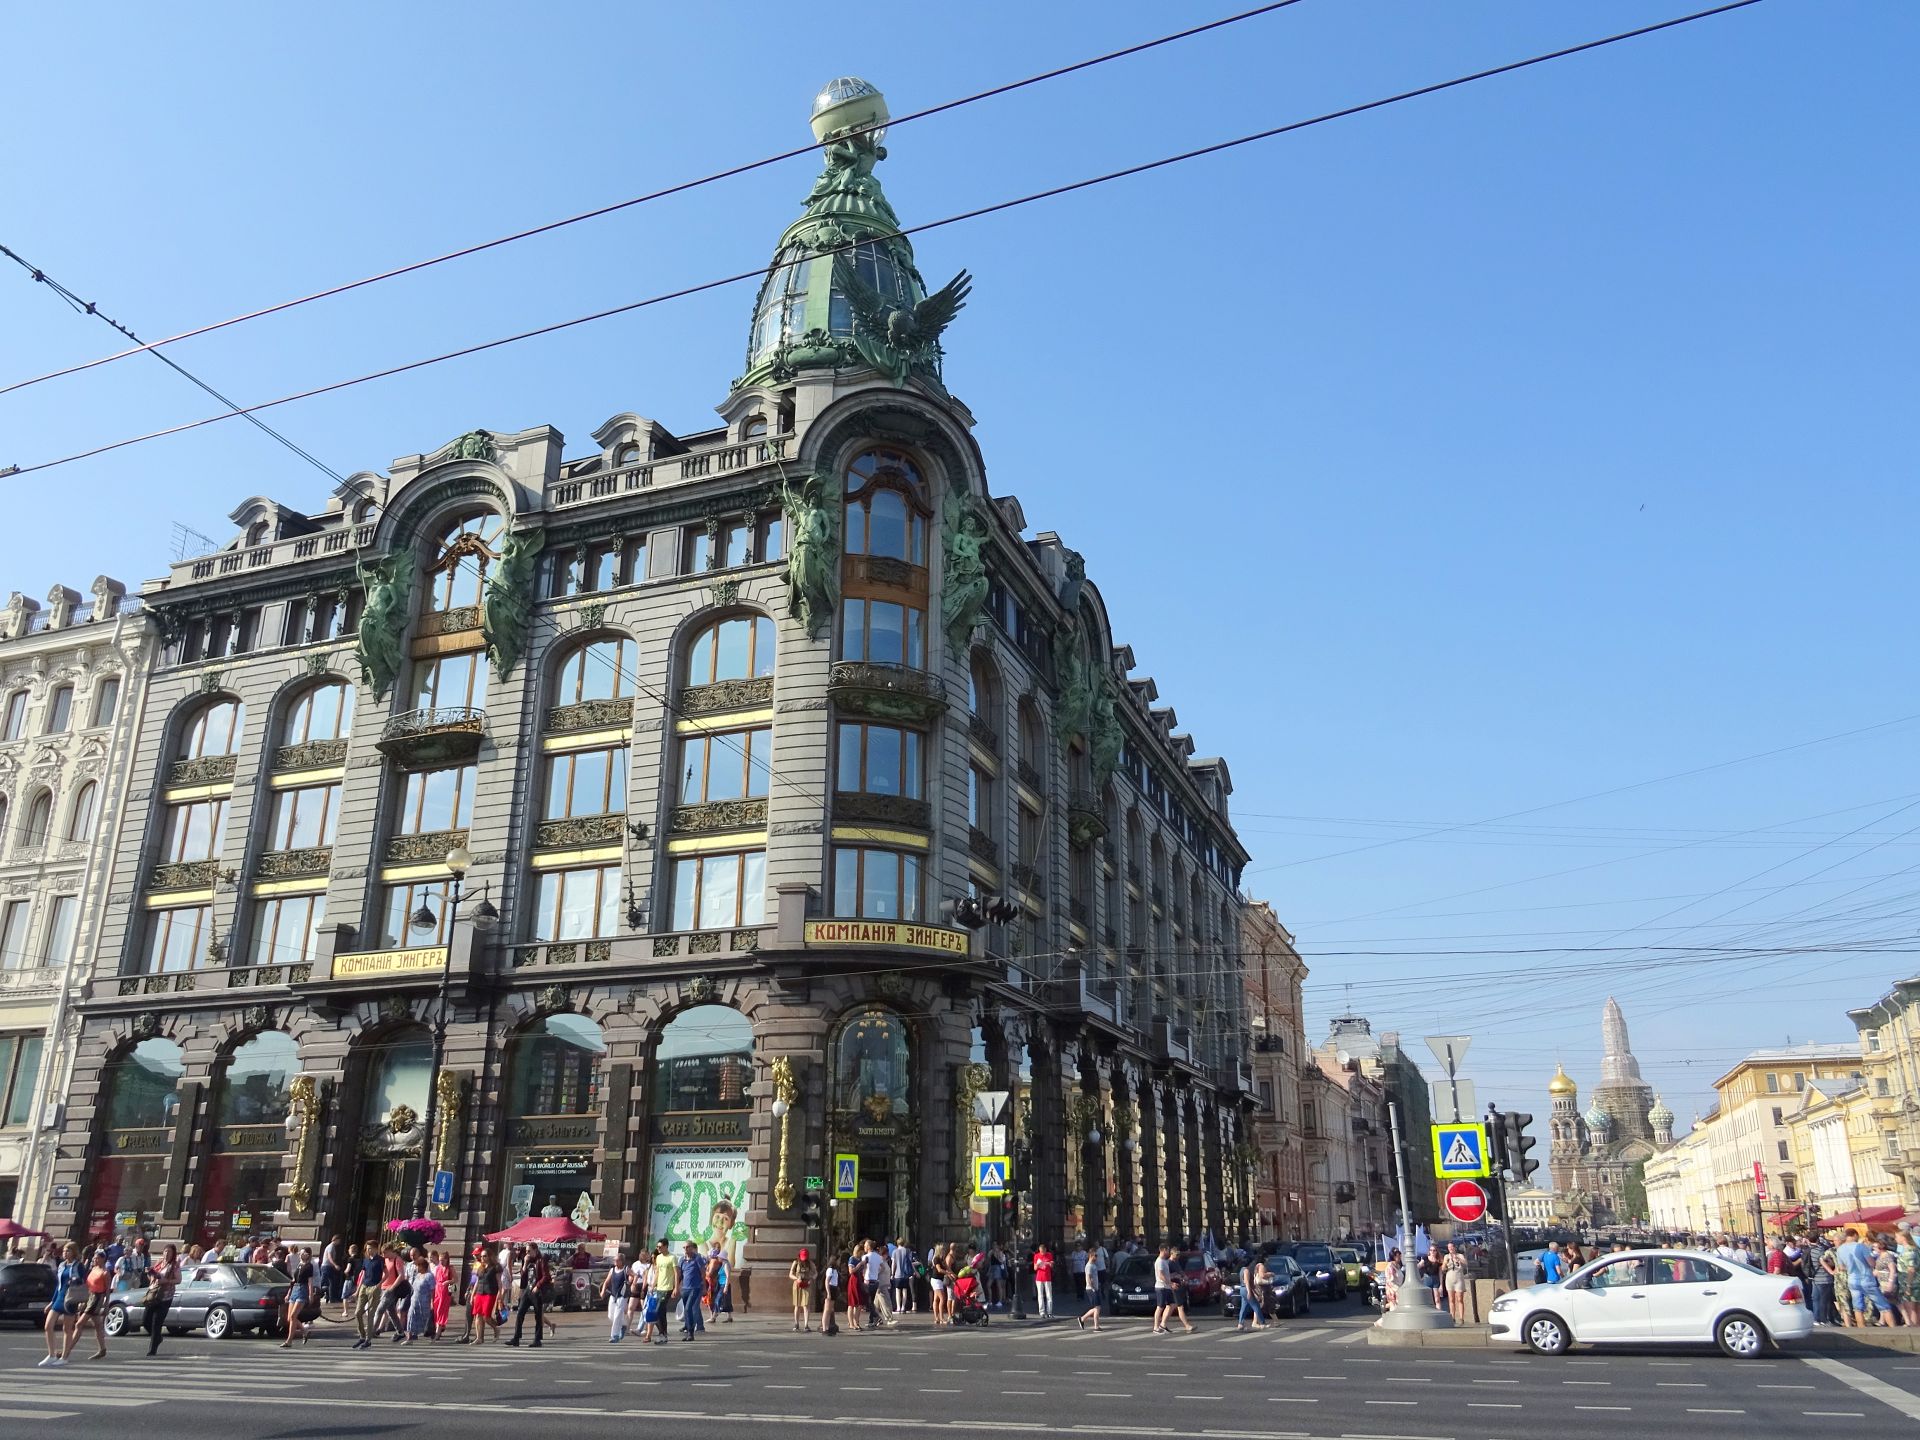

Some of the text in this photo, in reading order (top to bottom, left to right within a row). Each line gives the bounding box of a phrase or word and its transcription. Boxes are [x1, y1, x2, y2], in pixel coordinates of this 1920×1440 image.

[815, 924, 962, 951] КОМПАНІЯ ЗИНГЕРЪ
[665, 1160, 745, 1170] НА ДЕТСКУЮ ЛИТЕРАТУРУ
[686, 1171, 723, 1179] И ИГРУШКИ
